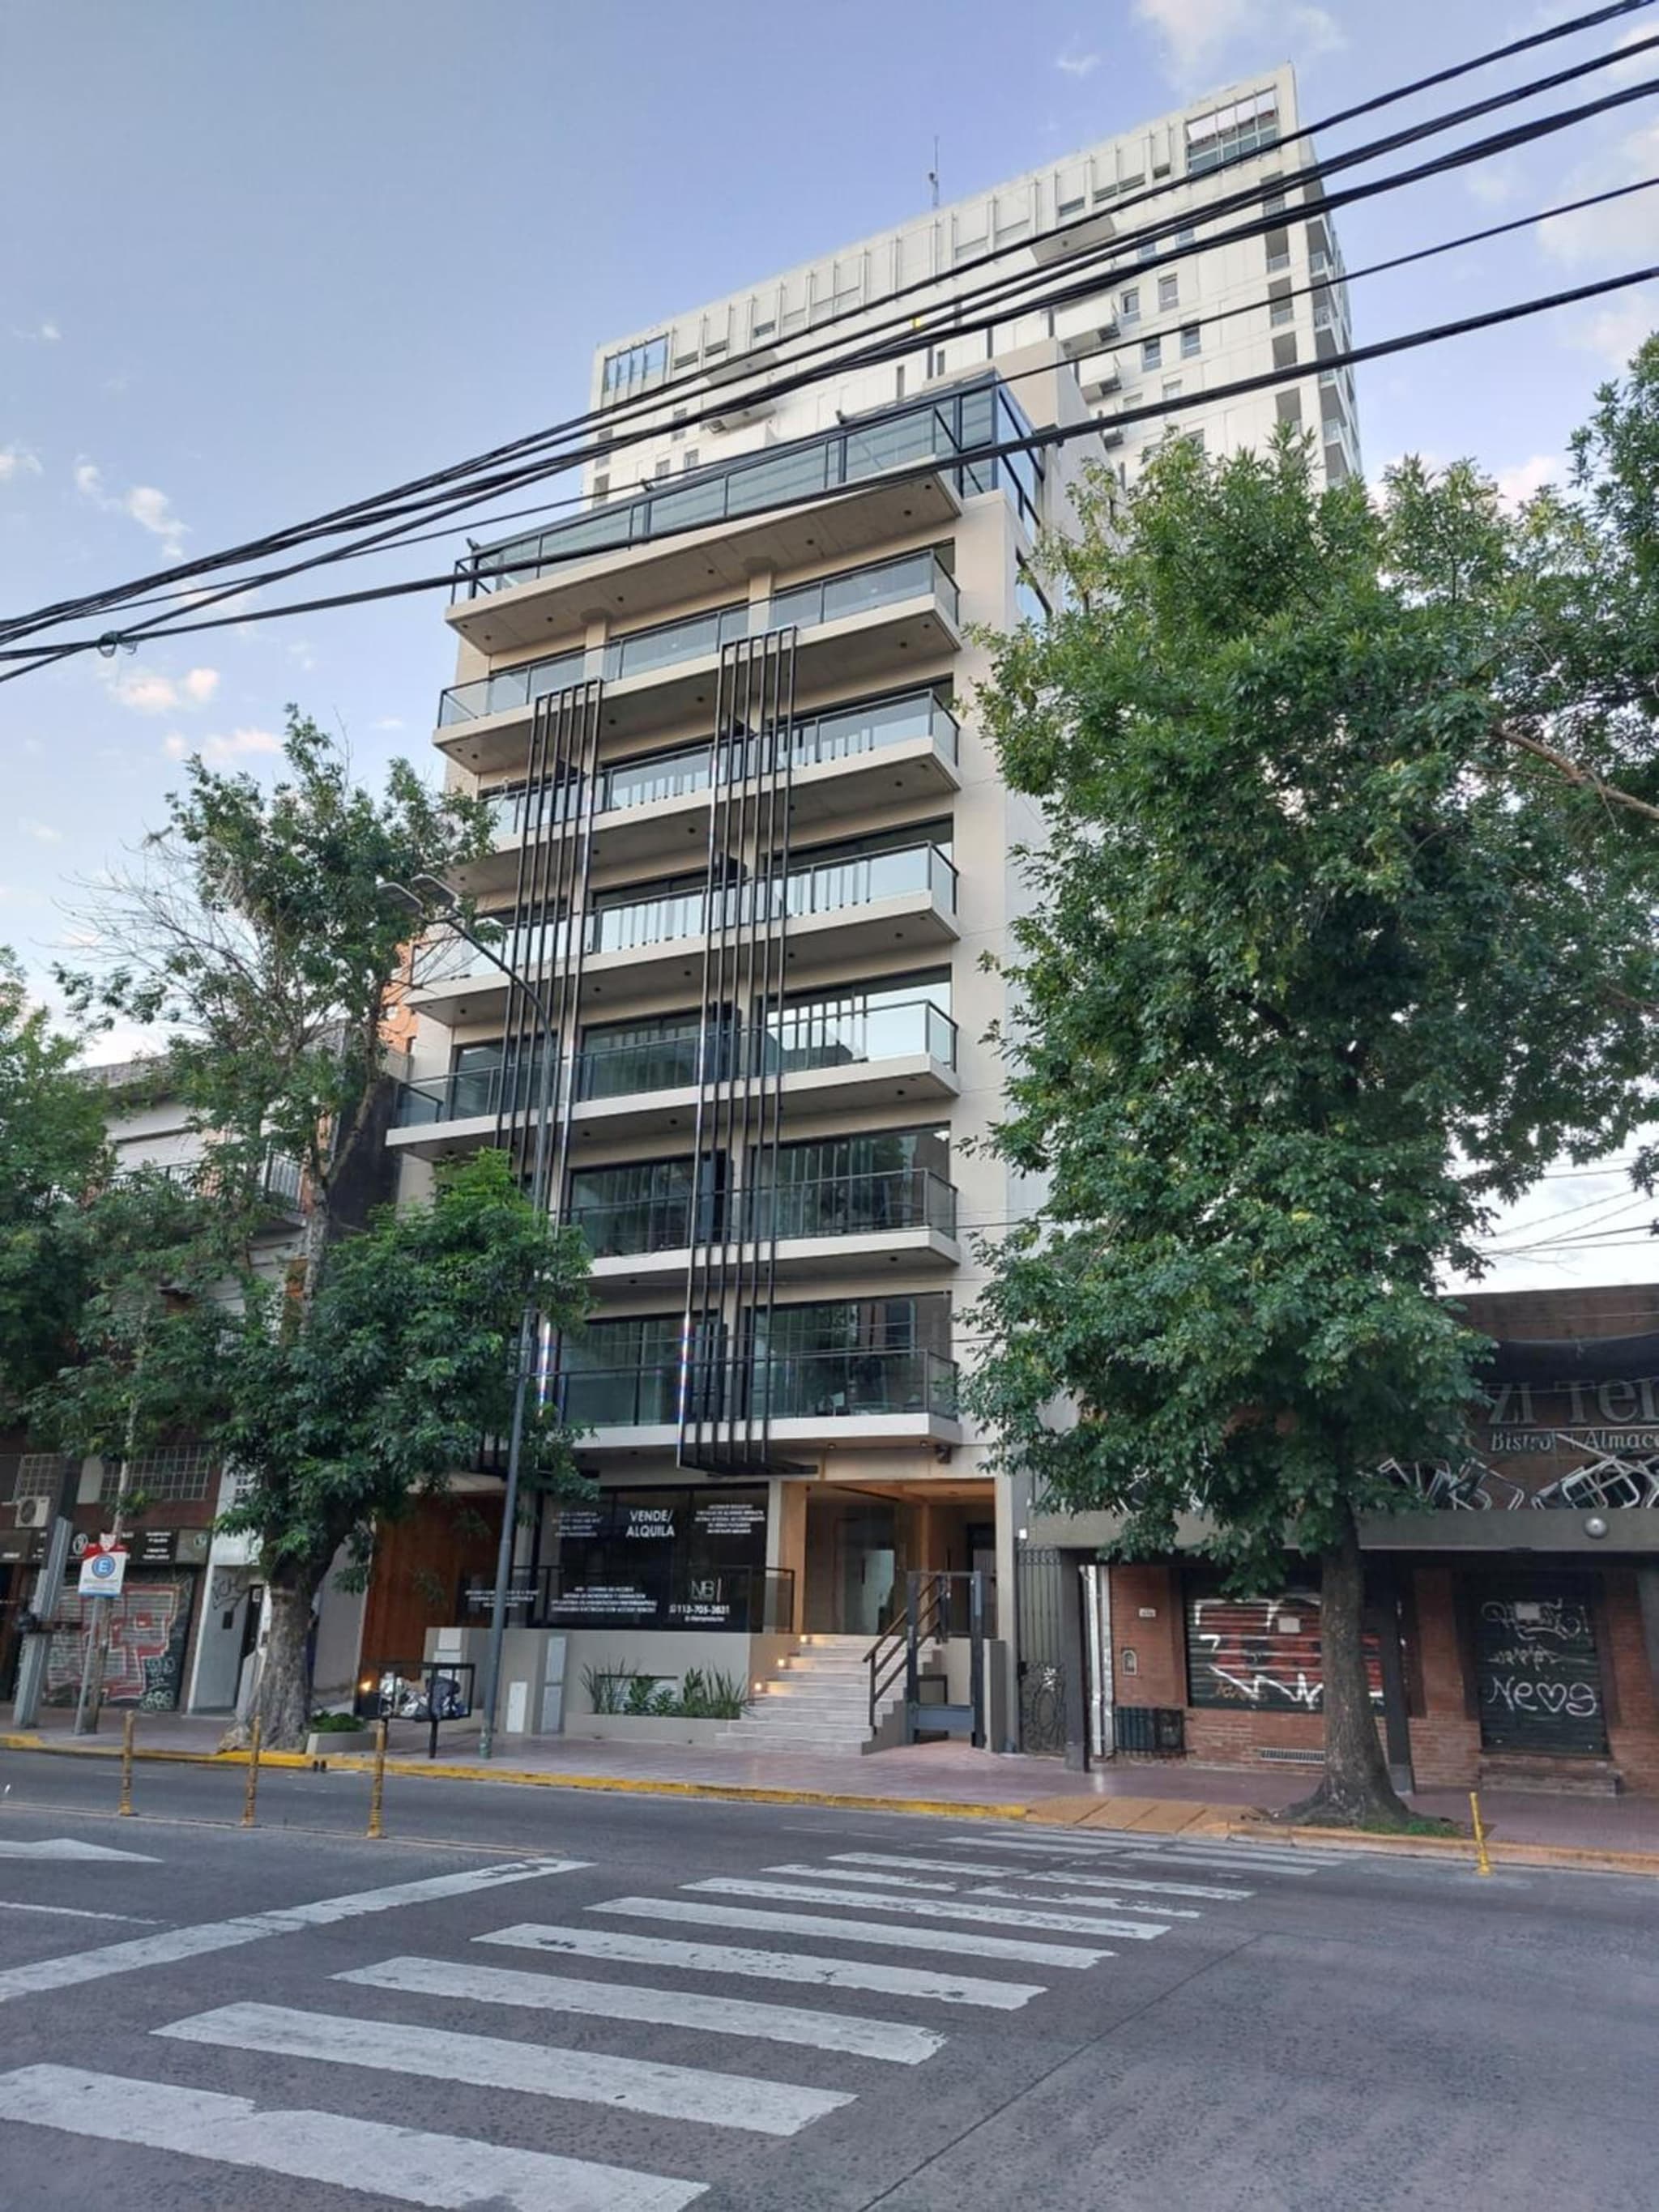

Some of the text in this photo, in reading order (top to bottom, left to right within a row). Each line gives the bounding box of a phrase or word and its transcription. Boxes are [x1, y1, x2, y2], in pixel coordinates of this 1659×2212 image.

[629, 1509, 673, 1523] VENDE/
[625, 1524, 675, 1537] ALQUILA
[98, 1559, 109, 1572] E
